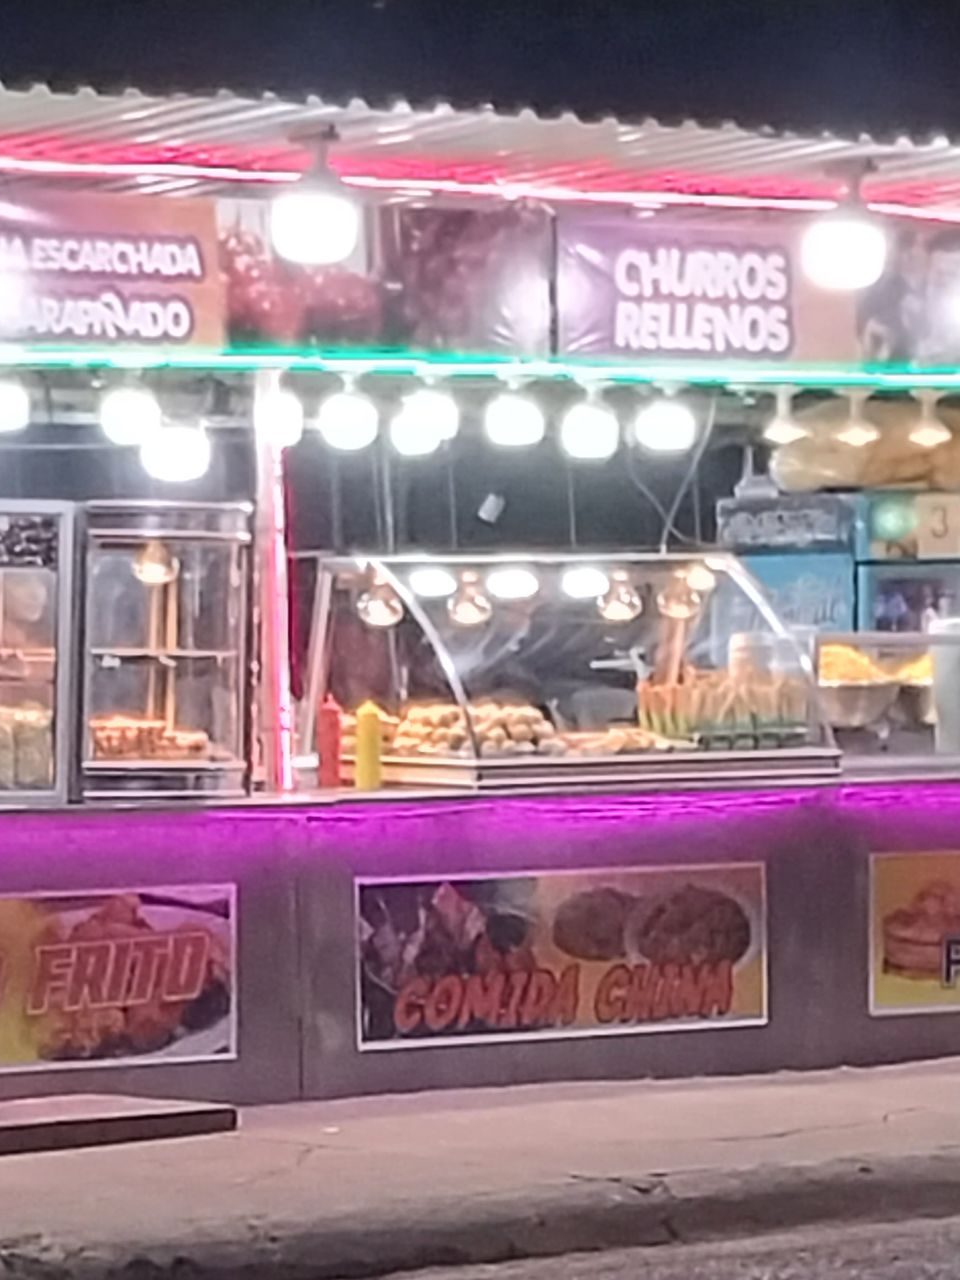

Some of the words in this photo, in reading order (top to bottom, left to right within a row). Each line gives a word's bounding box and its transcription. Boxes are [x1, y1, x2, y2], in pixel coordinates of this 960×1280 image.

[32, 236, 203, 277] ESCARCHADA
[615, 248, 788, 301] CHURROS
[3, 291, 191, 338] ARAPIÑADO
[615, 301, 790, 353] RELLENOS
[26, 931, 210, 1016] FRITO
[394, 962, 581, 1033] COMIDA
